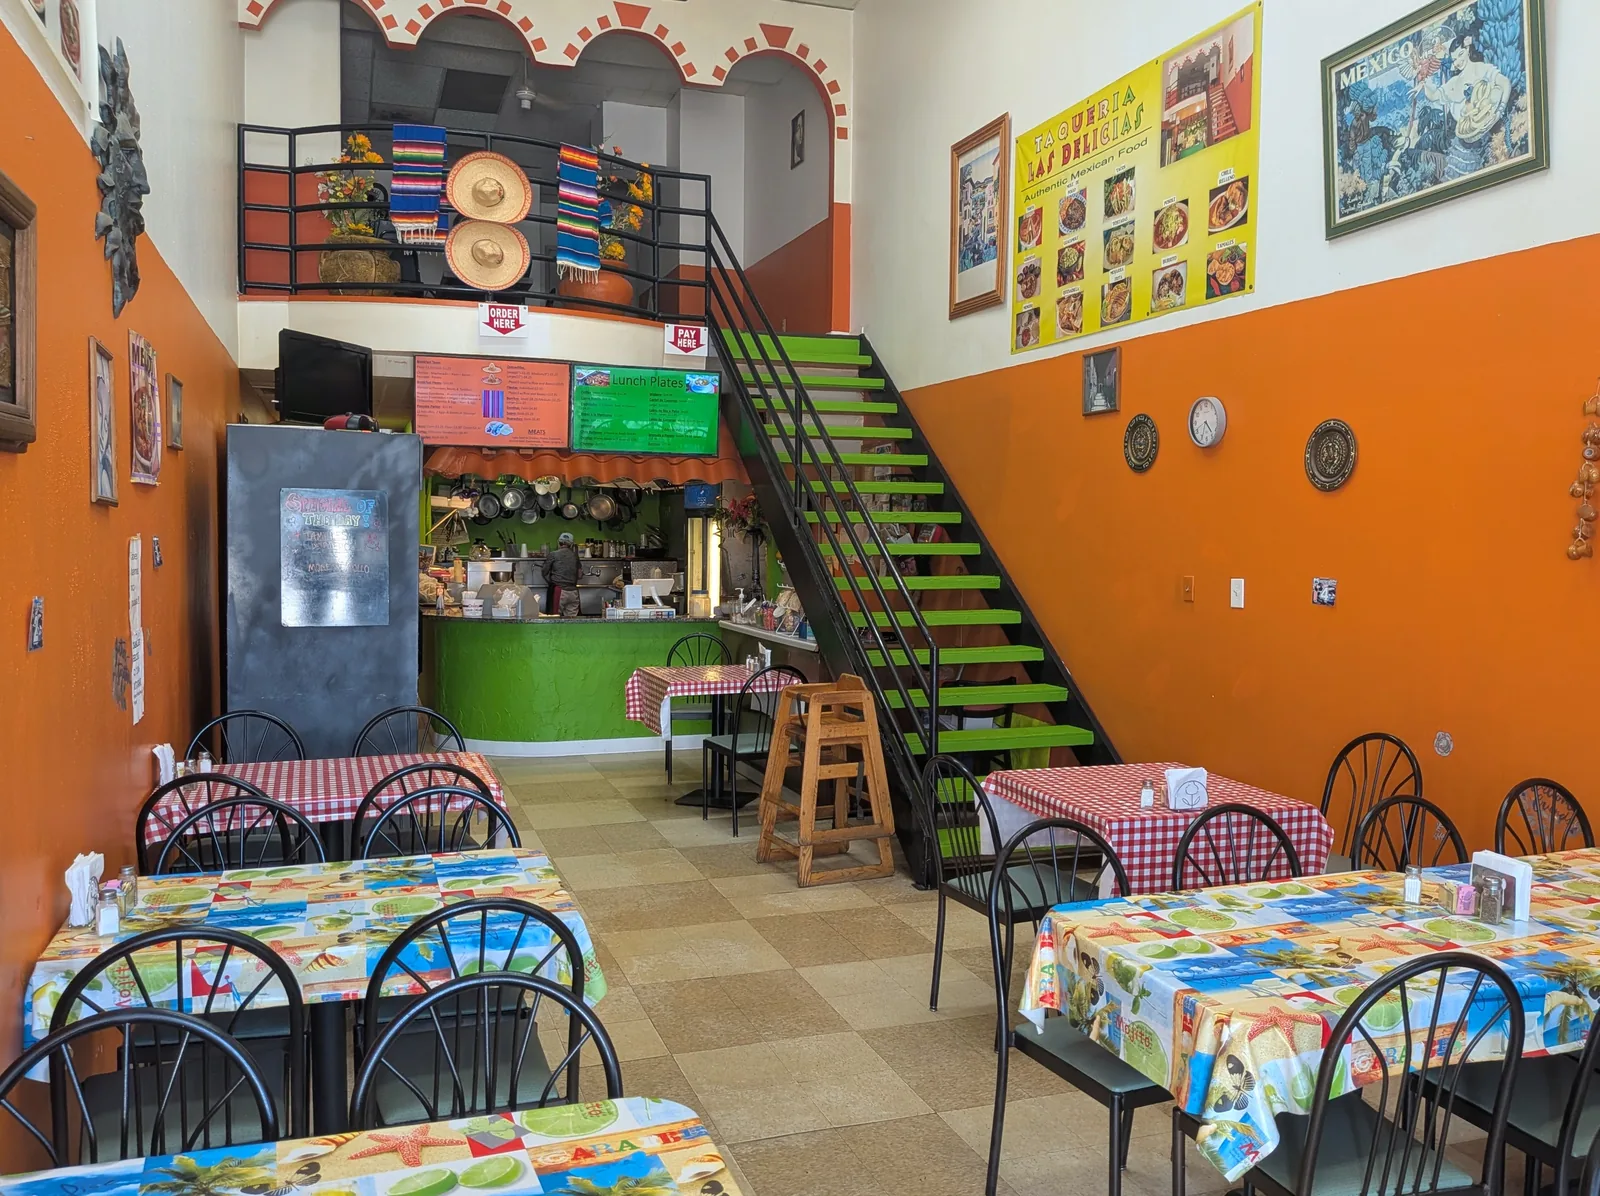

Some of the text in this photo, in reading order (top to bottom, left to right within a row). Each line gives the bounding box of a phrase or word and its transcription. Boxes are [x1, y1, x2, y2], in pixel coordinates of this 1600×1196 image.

[1035, 85, 1136, 154] TAQUERIA
[1028, 102, 1144, 183] LAS DELICIAS
[1024, 138, 1148, 203] Authentic Mexican Food
[490, 307, 518, 319] ORDER
[494, 319, 516, 329] HERE
[678, 329, 696, 339] PAY
[677, 338, 697, 348] HERE
[612, 374, 684, 388] Lunch Plates
[357, 499, 375, 514] OF
[1116, 1014, 1151, 1048] Mojito
